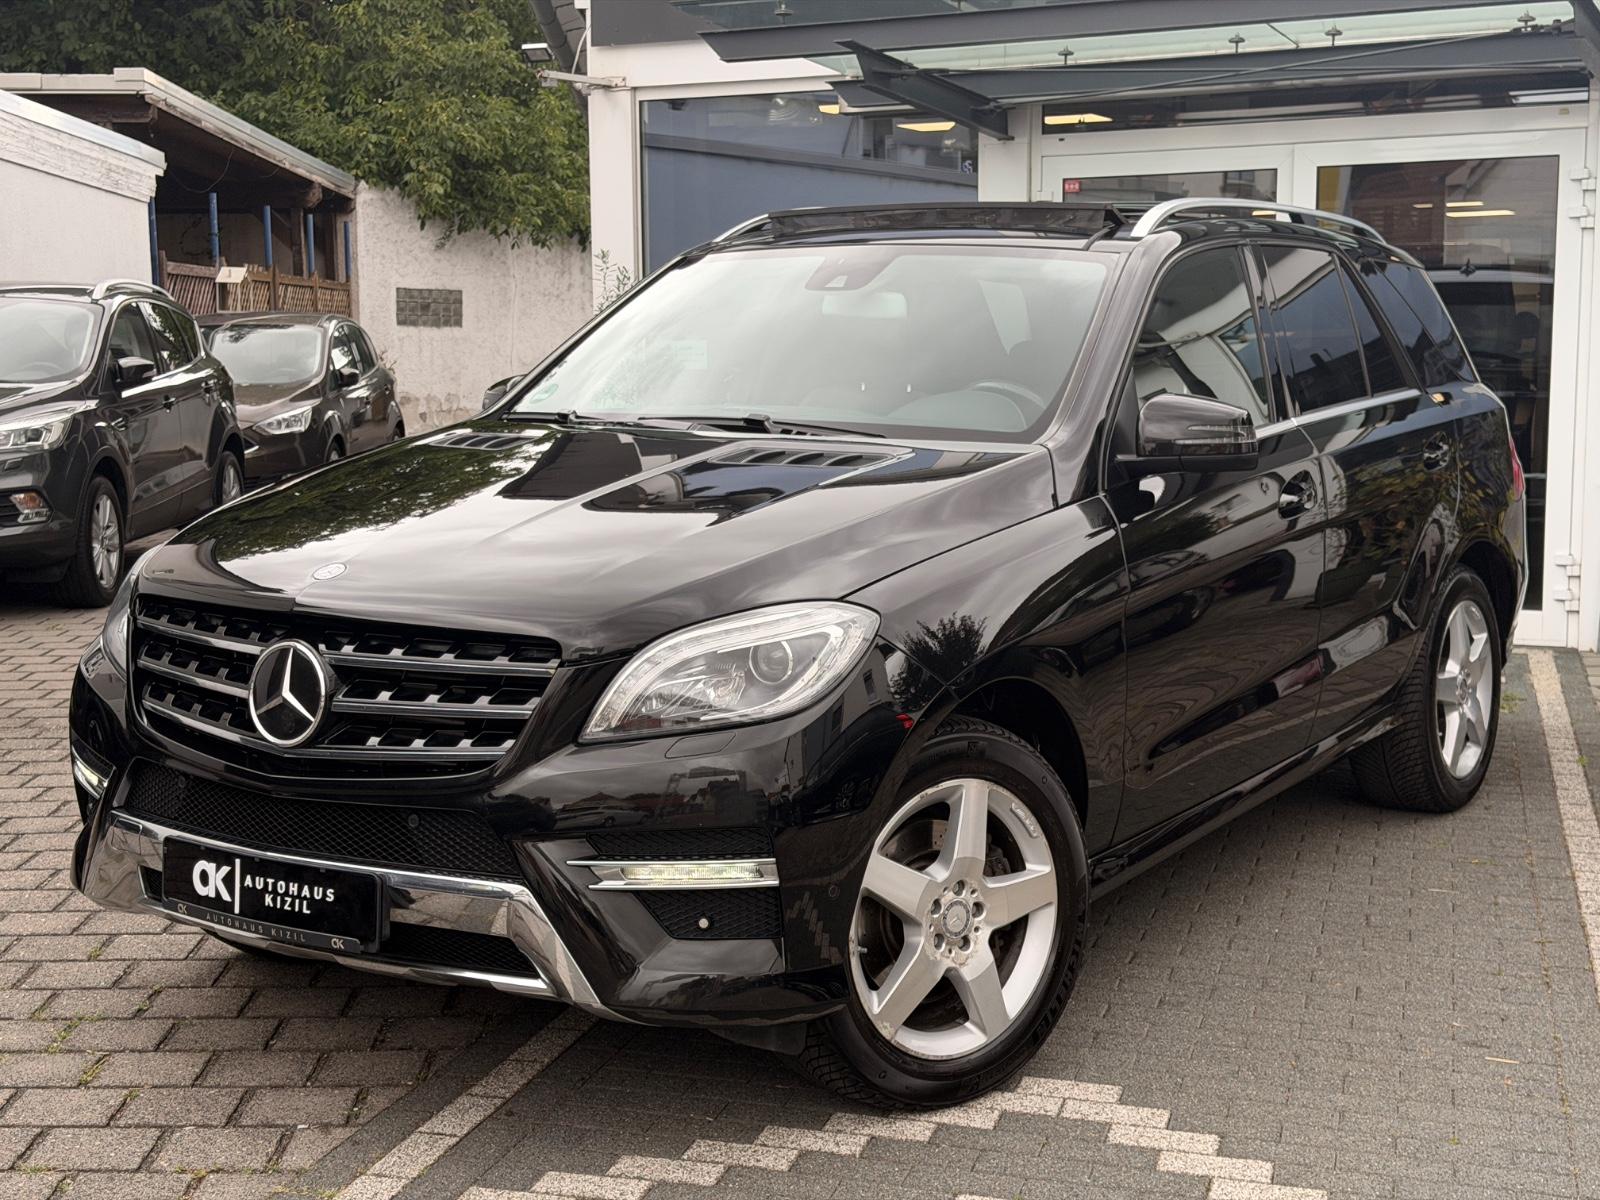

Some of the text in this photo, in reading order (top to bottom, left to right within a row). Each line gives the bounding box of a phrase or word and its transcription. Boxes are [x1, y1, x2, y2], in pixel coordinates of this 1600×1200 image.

[244, 874, 335, 902] AUTOHAUS
[264, 893, 311, 914] KIZIL
[205, 913, 306, 943] AUTOHAUS KIZIL
